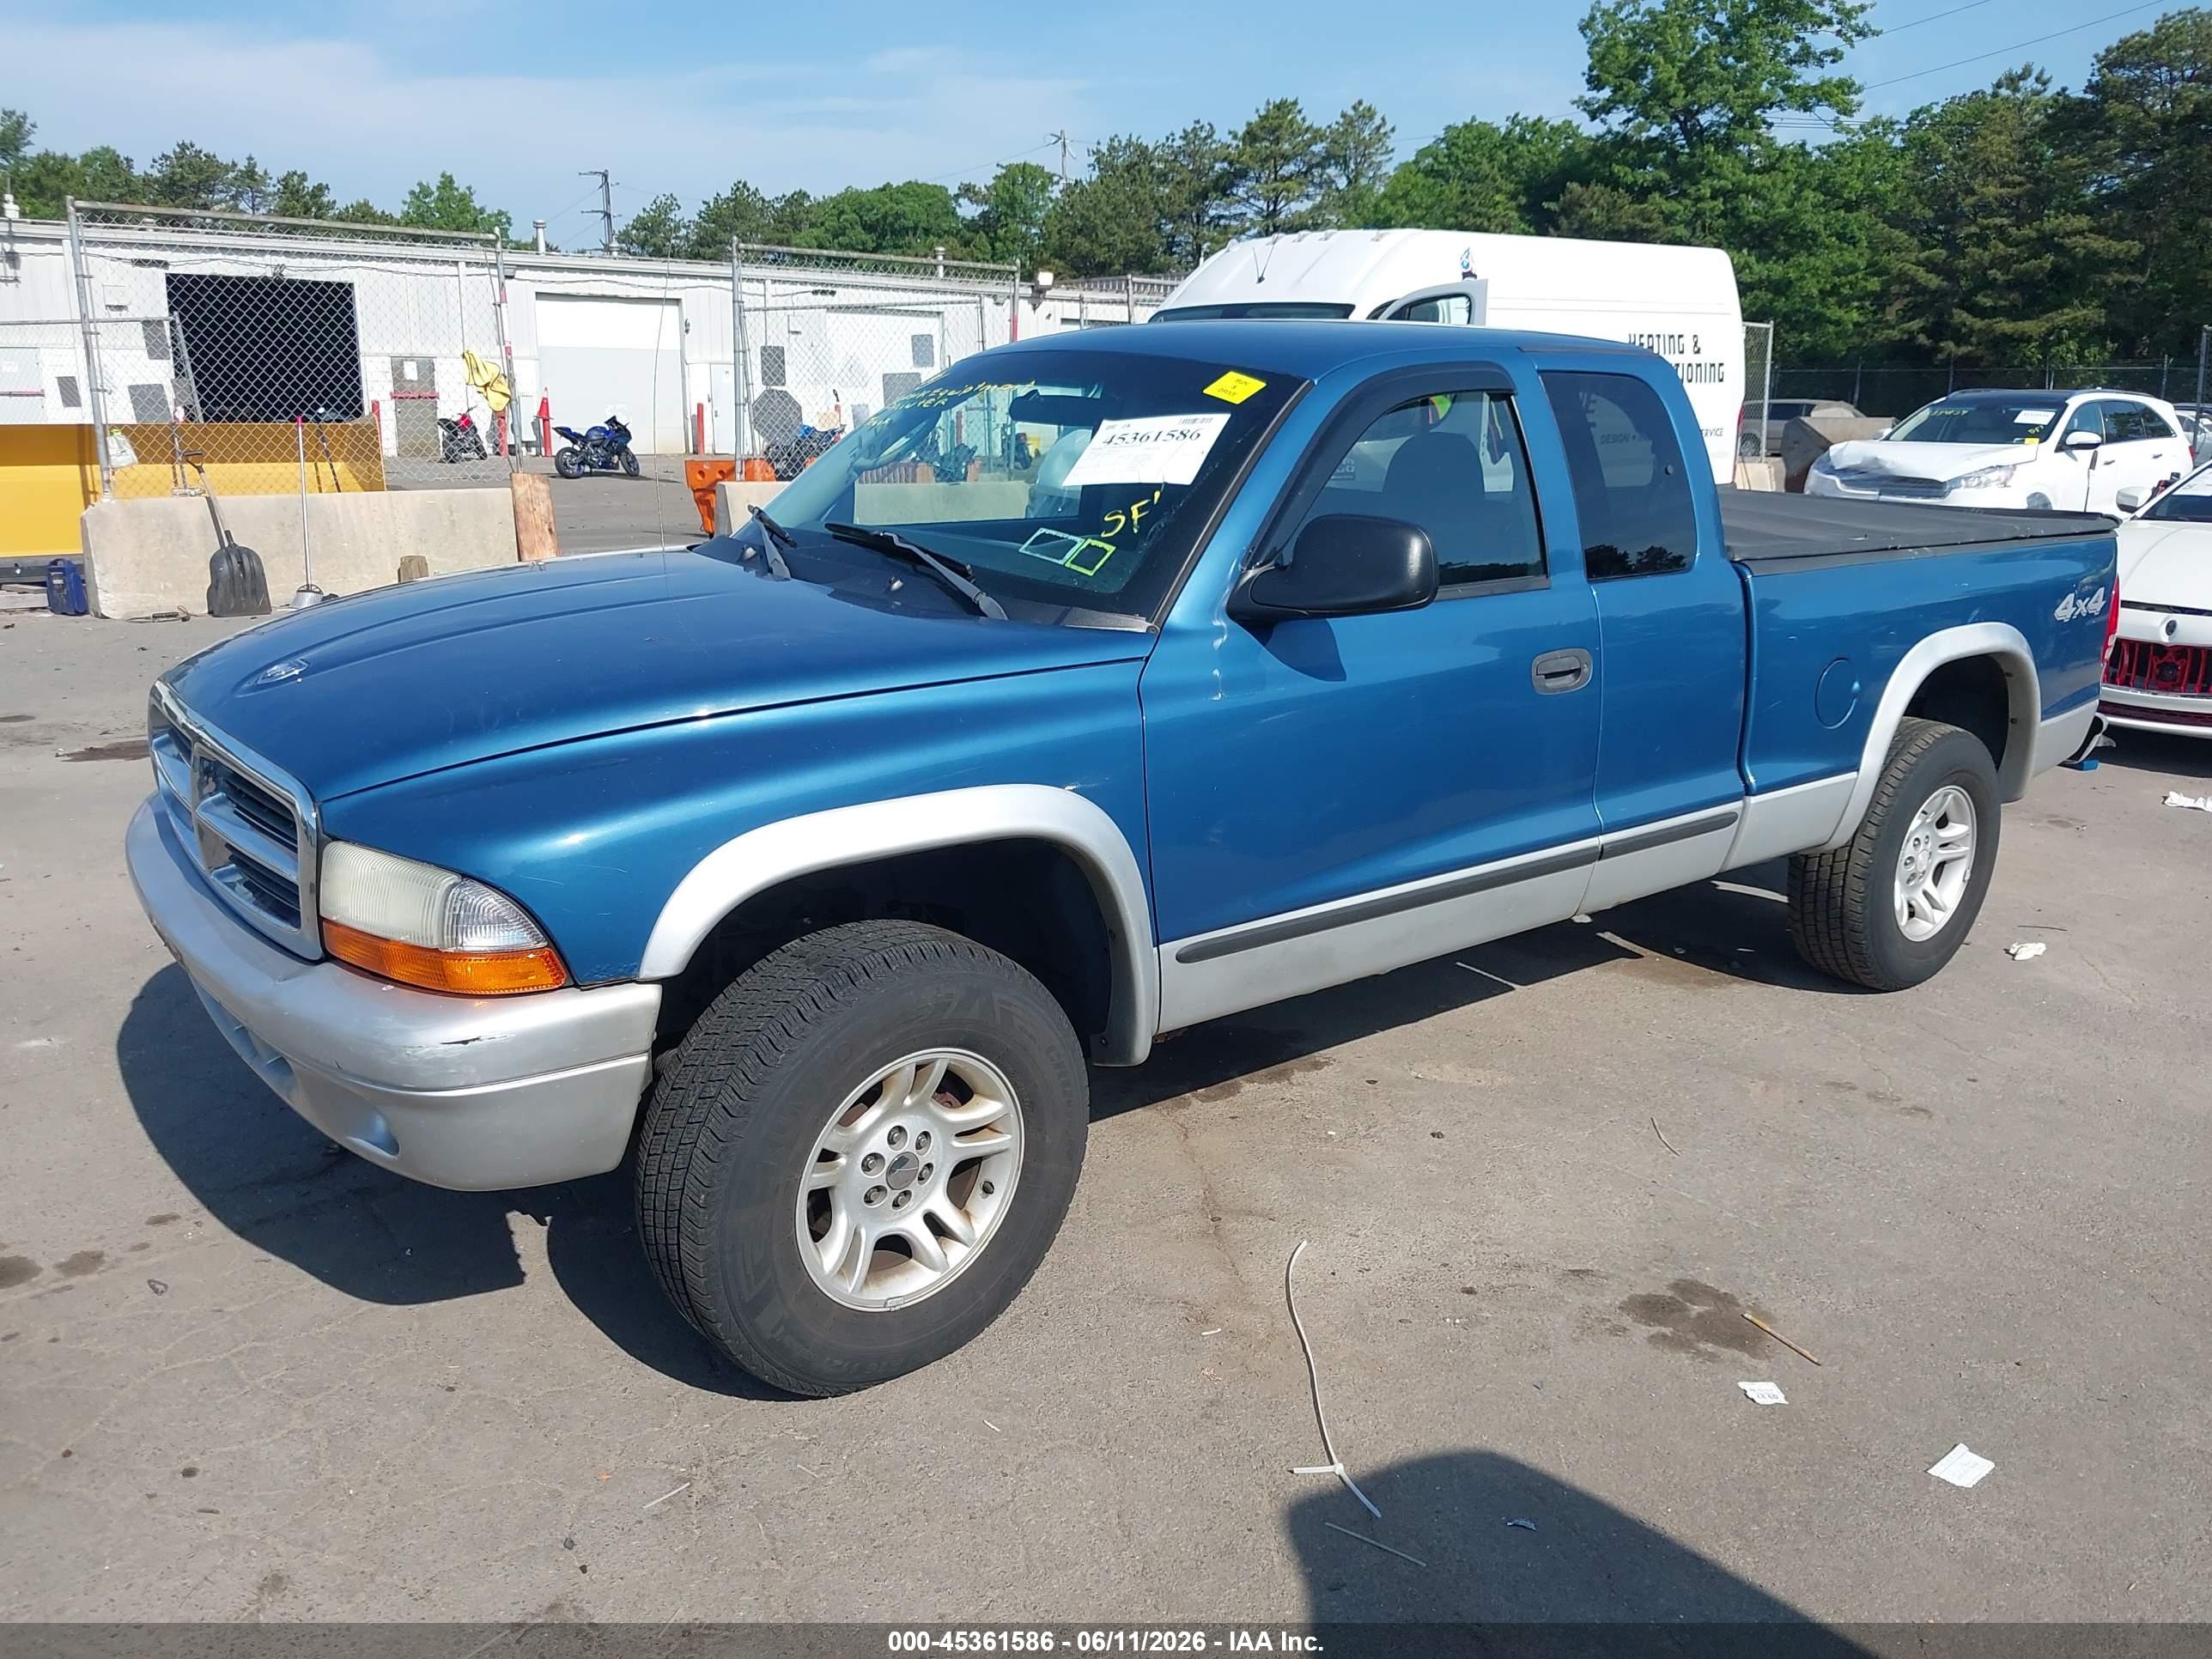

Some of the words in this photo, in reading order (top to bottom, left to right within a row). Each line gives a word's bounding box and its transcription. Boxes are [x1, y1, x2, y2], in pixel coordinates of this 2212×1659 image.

[1692, 334, 1701, 355] &
[1103, 428, 1201, 446] 45361586
[2053, 586, 2106, 623] 4x4
